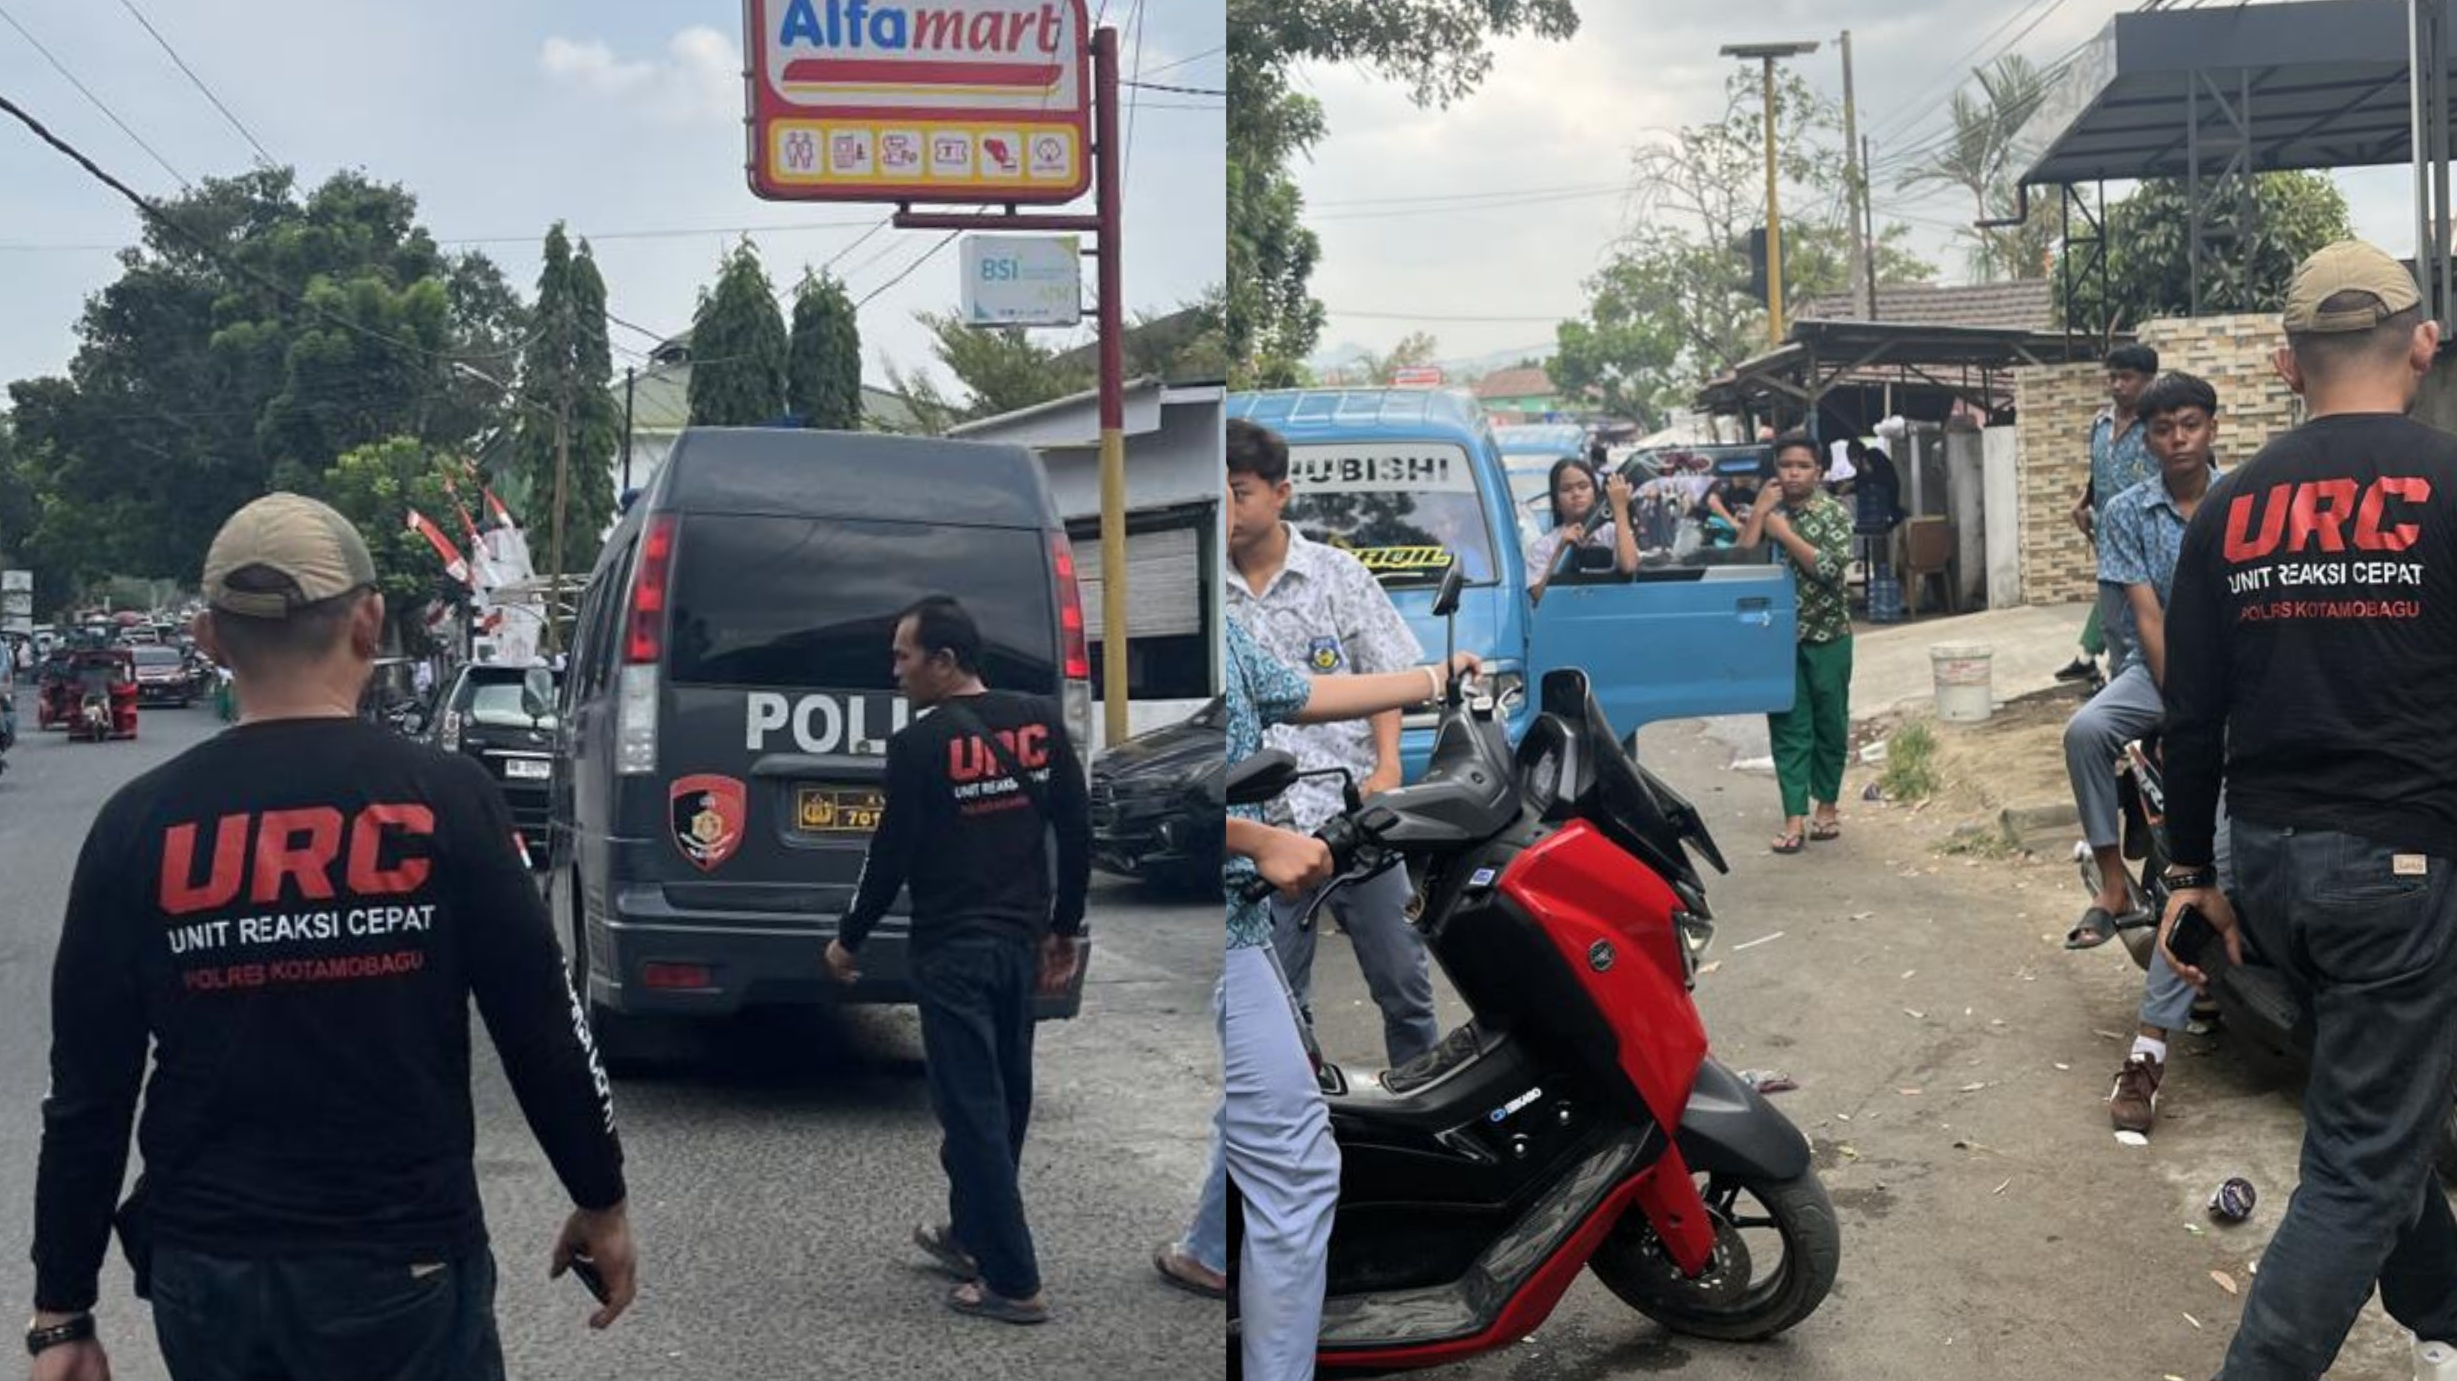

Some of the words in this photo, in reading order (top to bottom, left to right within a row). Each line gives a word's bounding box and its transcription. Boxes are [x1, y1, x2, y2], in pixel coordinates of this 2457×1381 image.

[779, 0, 1063, 53] Alfamart
[981, 258, 1018, 281] BSI
[2222, 475, 2431, 564] URC
[2228, 566, 2272, 594] UNIT
[2278, 562, 2346, 586] REAKSI
[2352, 561, 2424, 585] CEPAT
[2294, 600, 2420, 617] KOTAMOBAGU
[746, 691, 938, 754] POLI
[159, 803, 434, 915] URC
[167, 921, 230, 954] UNIT
[239, 912, 340, 945] REAKSI
[347, 904, 436, 936] CEPAT
[185, 962, 265, 990] POLRES
[270, 951, 424, 980] KOTAMOBAGU
